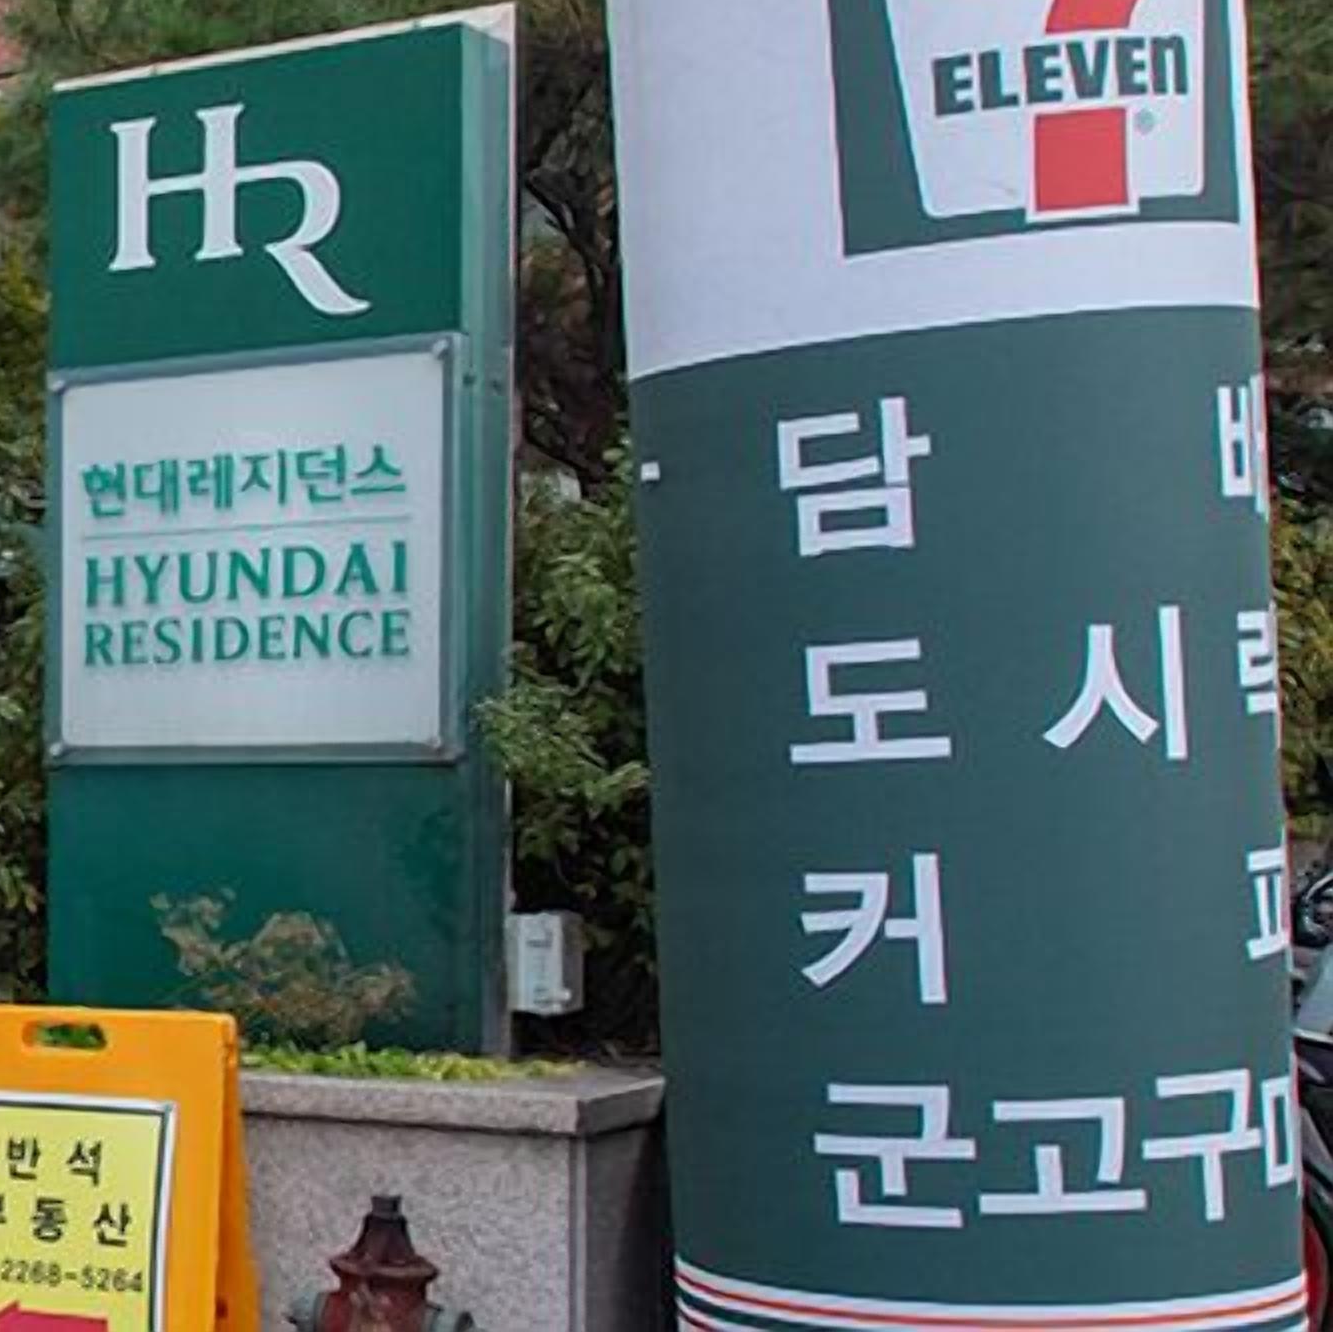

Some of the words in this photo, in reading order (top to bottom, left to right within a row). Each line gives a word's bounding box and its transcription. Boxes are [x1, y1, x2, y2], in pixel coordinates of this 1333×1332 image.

[108, 102, 371, 316] HR
[82, 443, 408, 520] 현대레지던스
[85, 540, 408, 609] HYUNDAI
[84, 609, 411, 668] RESIDENCE
